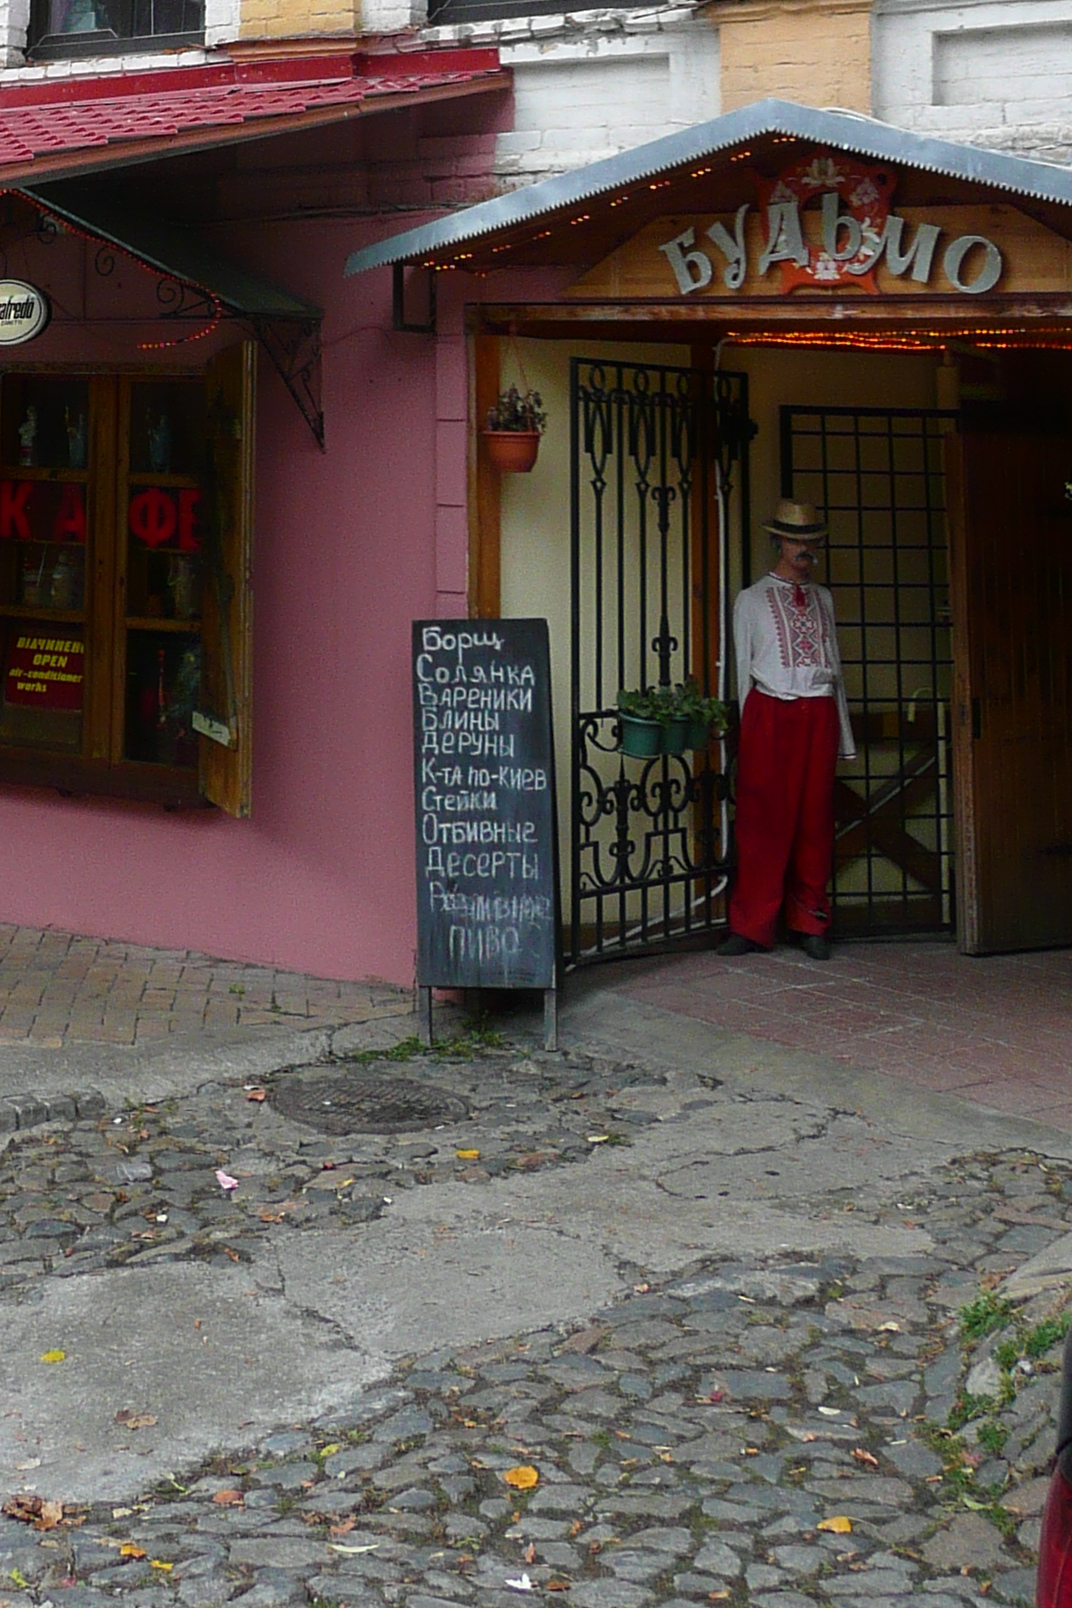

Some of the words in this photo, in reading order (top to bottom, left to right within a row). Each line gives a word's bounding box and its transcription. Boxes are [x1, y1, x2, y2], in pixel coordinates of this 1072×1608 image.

[659, 191, 1003, 294] БУДЬМО
[421, 625, 505, 664] Борщ
[33, 654, 68, 668] OPEN
[9, 668, 83, 683] air-conditioner
[17, 682, 47, 692] works
[421, 707, 500, 732] Блины
[421, 785, 498, 812] Стейки
[425, 846, 540, 880] Десерты
